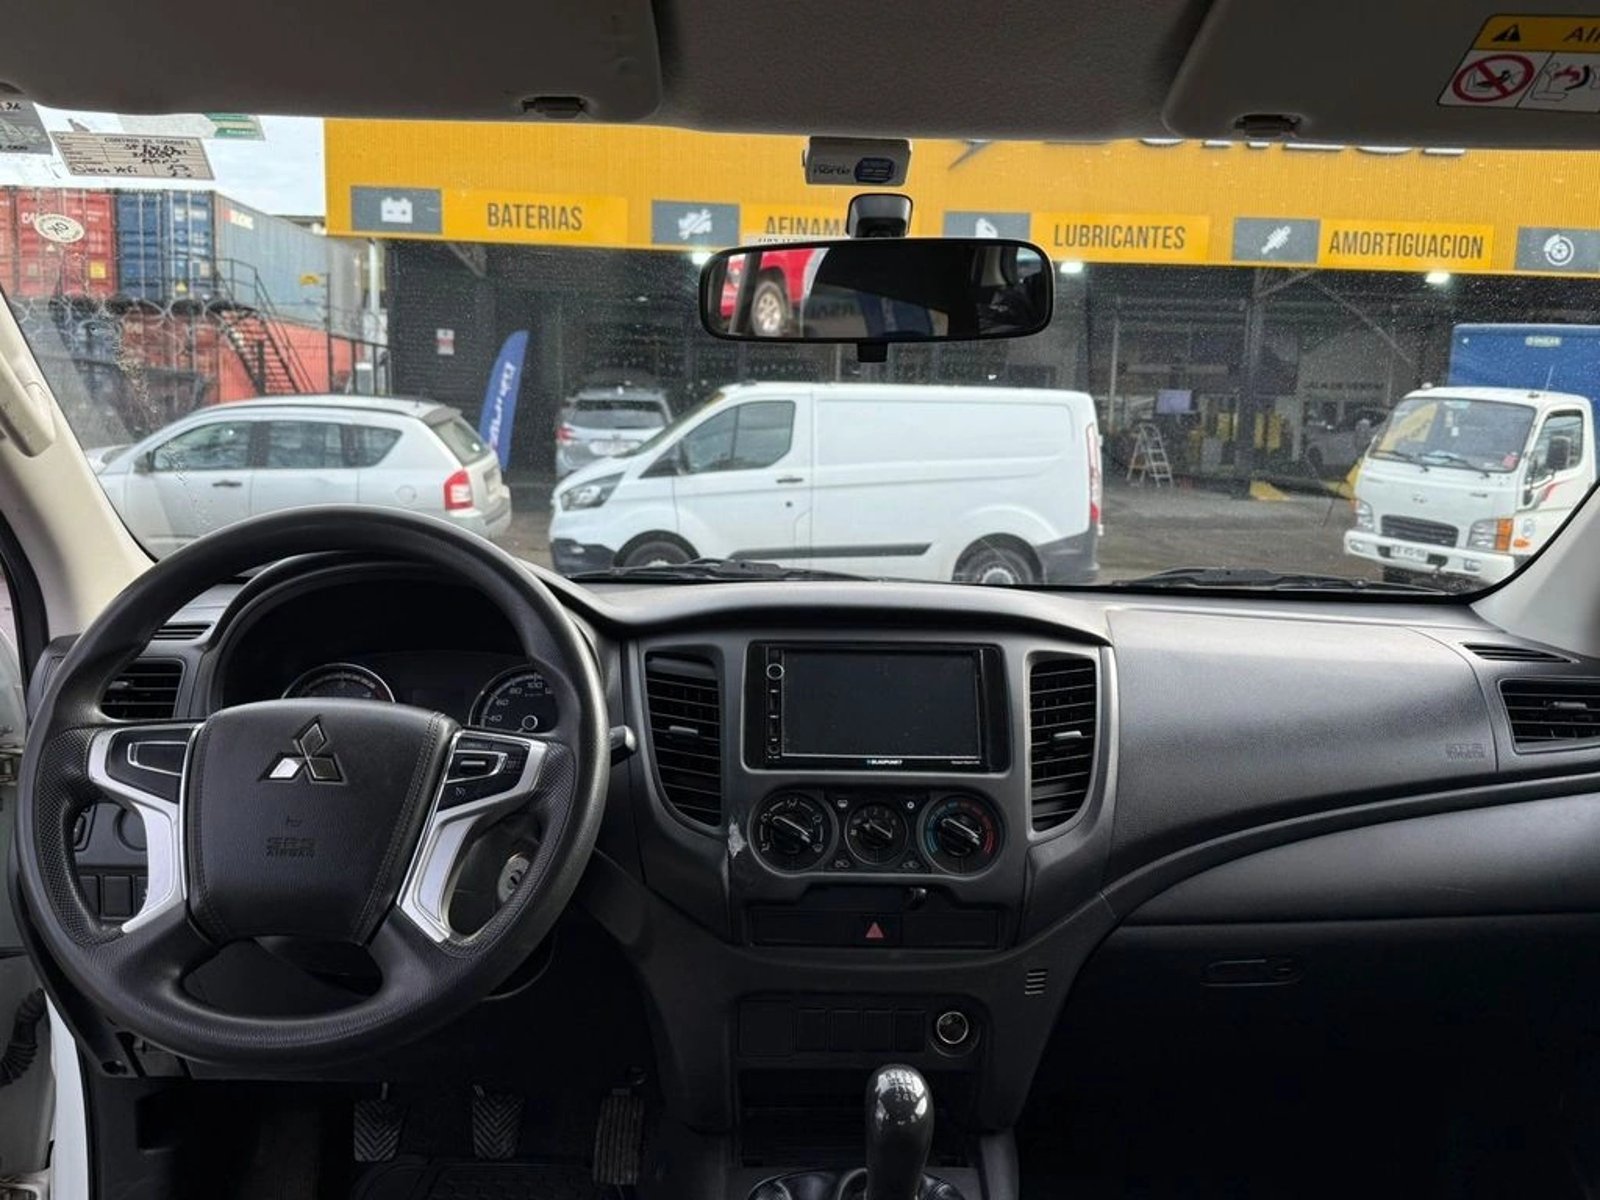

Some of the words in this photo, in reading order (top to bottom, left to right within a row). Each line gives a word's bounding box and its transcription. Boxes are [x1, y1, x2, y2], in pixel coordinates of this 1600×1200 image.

[486, 202, 583, 231] BATERIAS
[766, 216, 843, 235] AFINAM
[1054, 223, 1186, 249] LUBRICANTES
[1329, 228, 1484, 259] AMORTIGUACION
